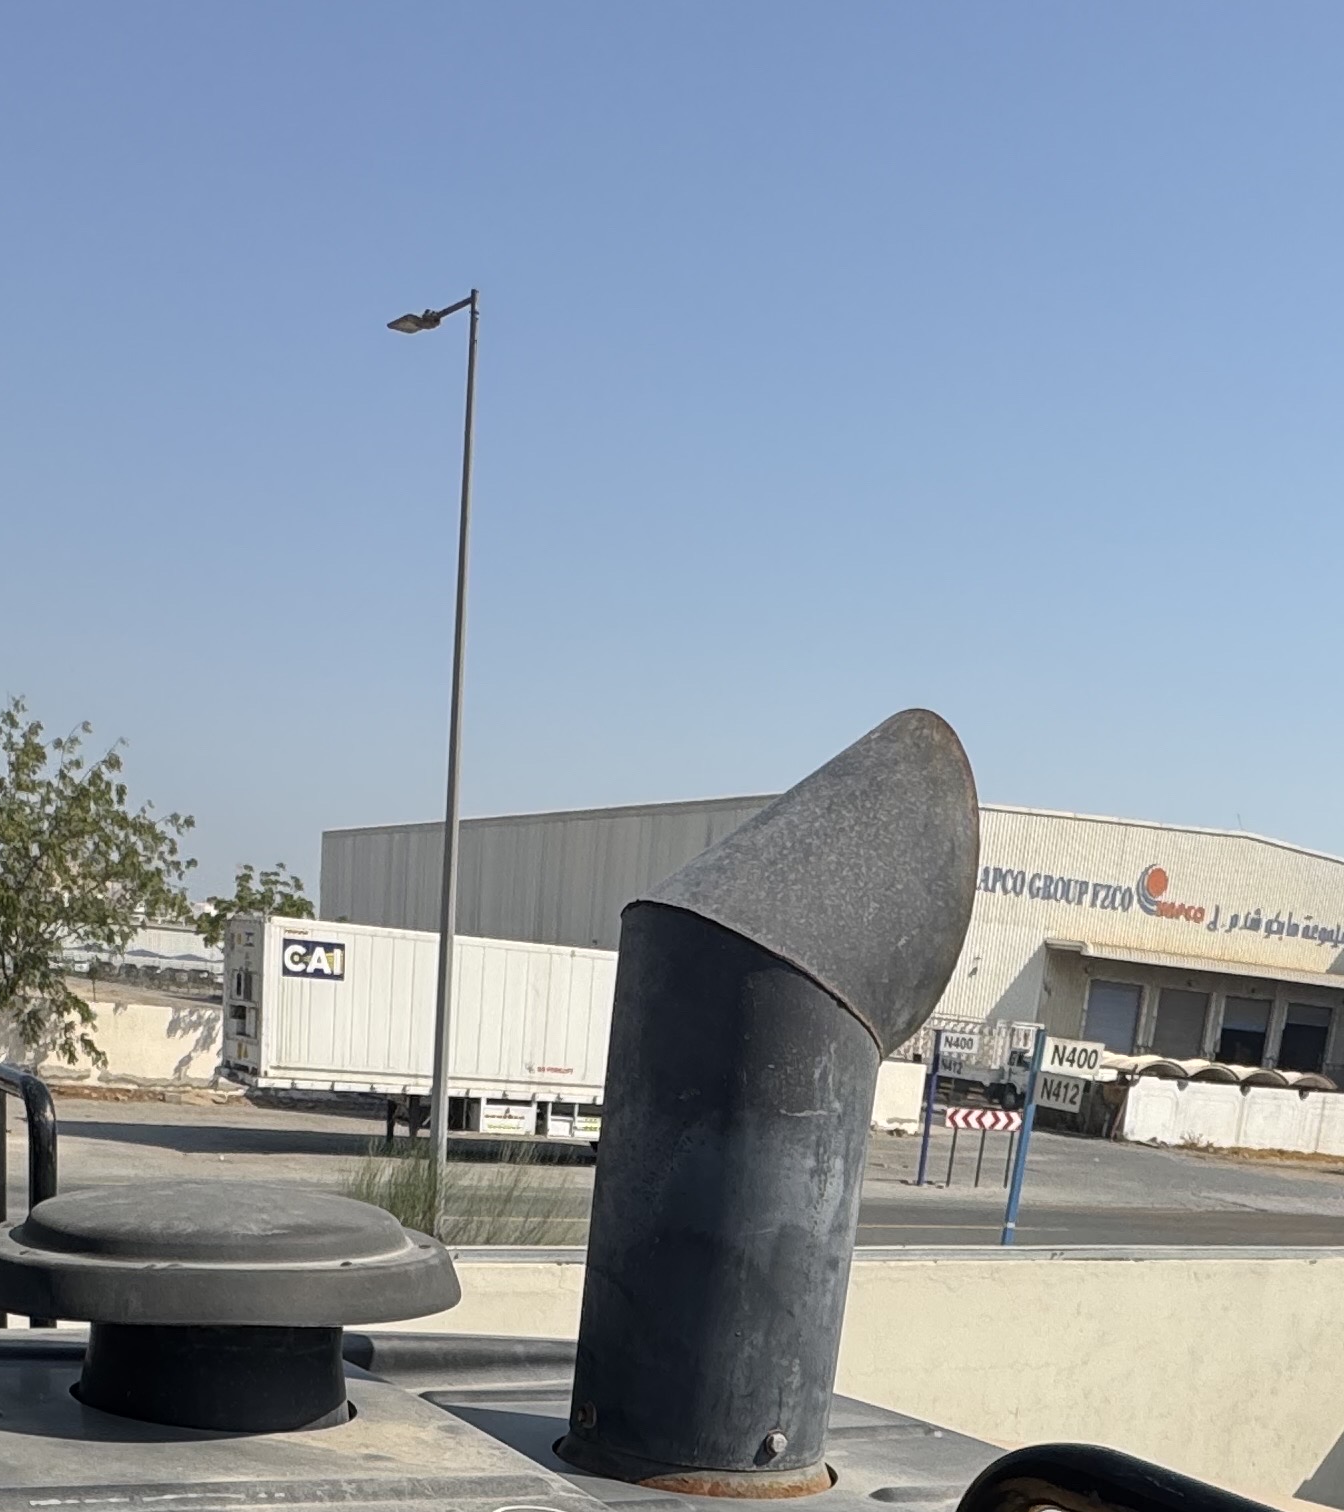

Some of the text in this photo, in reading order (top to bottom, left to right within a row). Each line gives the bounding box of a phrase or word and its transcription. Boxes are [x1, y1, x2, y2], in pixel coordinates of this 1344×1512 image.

[976, 865, 1026, 898] APCO
[1028, 872, 1090, 906] GROUP
[284, 944, 342, 975] CAI
[944, 1035, 974, 1050] N400
[1050, 1043, 1099, 1071] N400
[1040, 1076, 1081, 1106] N412
